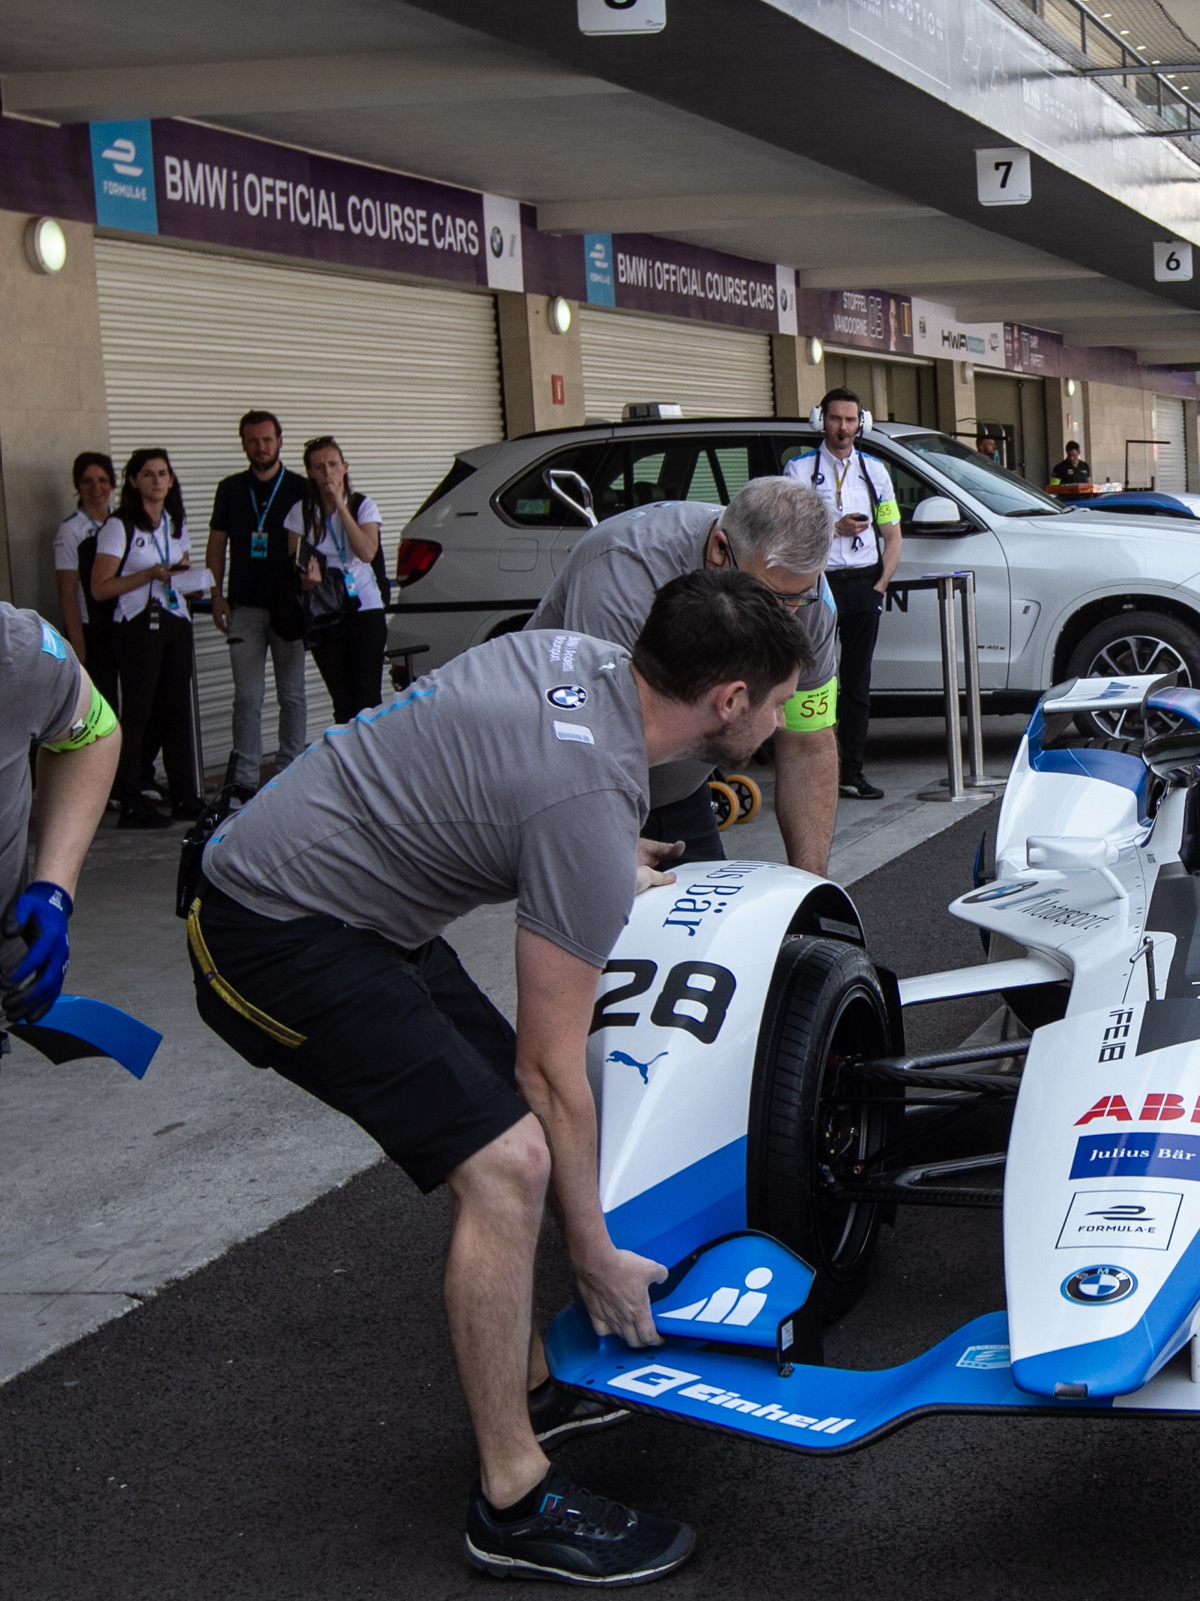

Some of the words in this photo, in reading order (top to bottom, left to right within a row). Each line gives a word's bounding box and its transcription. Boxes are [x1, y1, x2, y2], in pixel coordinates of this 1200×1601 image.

[994, 161, 1013, 189] 7
[164, 155, 227, 211] BMW
[232, 171, 239, 212] i
[244, 173, 345, 232] OFFICIAL
[347, 195, 429, 246] COURSE
[432, 212, 479, 256] CARS
[1165, 251, 1181, 271] 6
[617, 252, 648, 288] BMW
[655, 261, 705, 297] OFFICIAL
[705, 271, 748, 306] COURSE
[749, 281, 775, 311] CARS
[843, 291, 868, 312] STOFFEL
[833, 314, 868, 336] VANDOORNE
[941, 330, 968, 351] HWA
[879, 506, 892, 517] S5
[800, 695, 829, 718] S5
[662, 884, 744, 937] Bär
[588, 959, 737, 1044] 28
[1089, 1148, 1150, 1161] Julius
[1157, 1148, 1196, 1161] Bär
